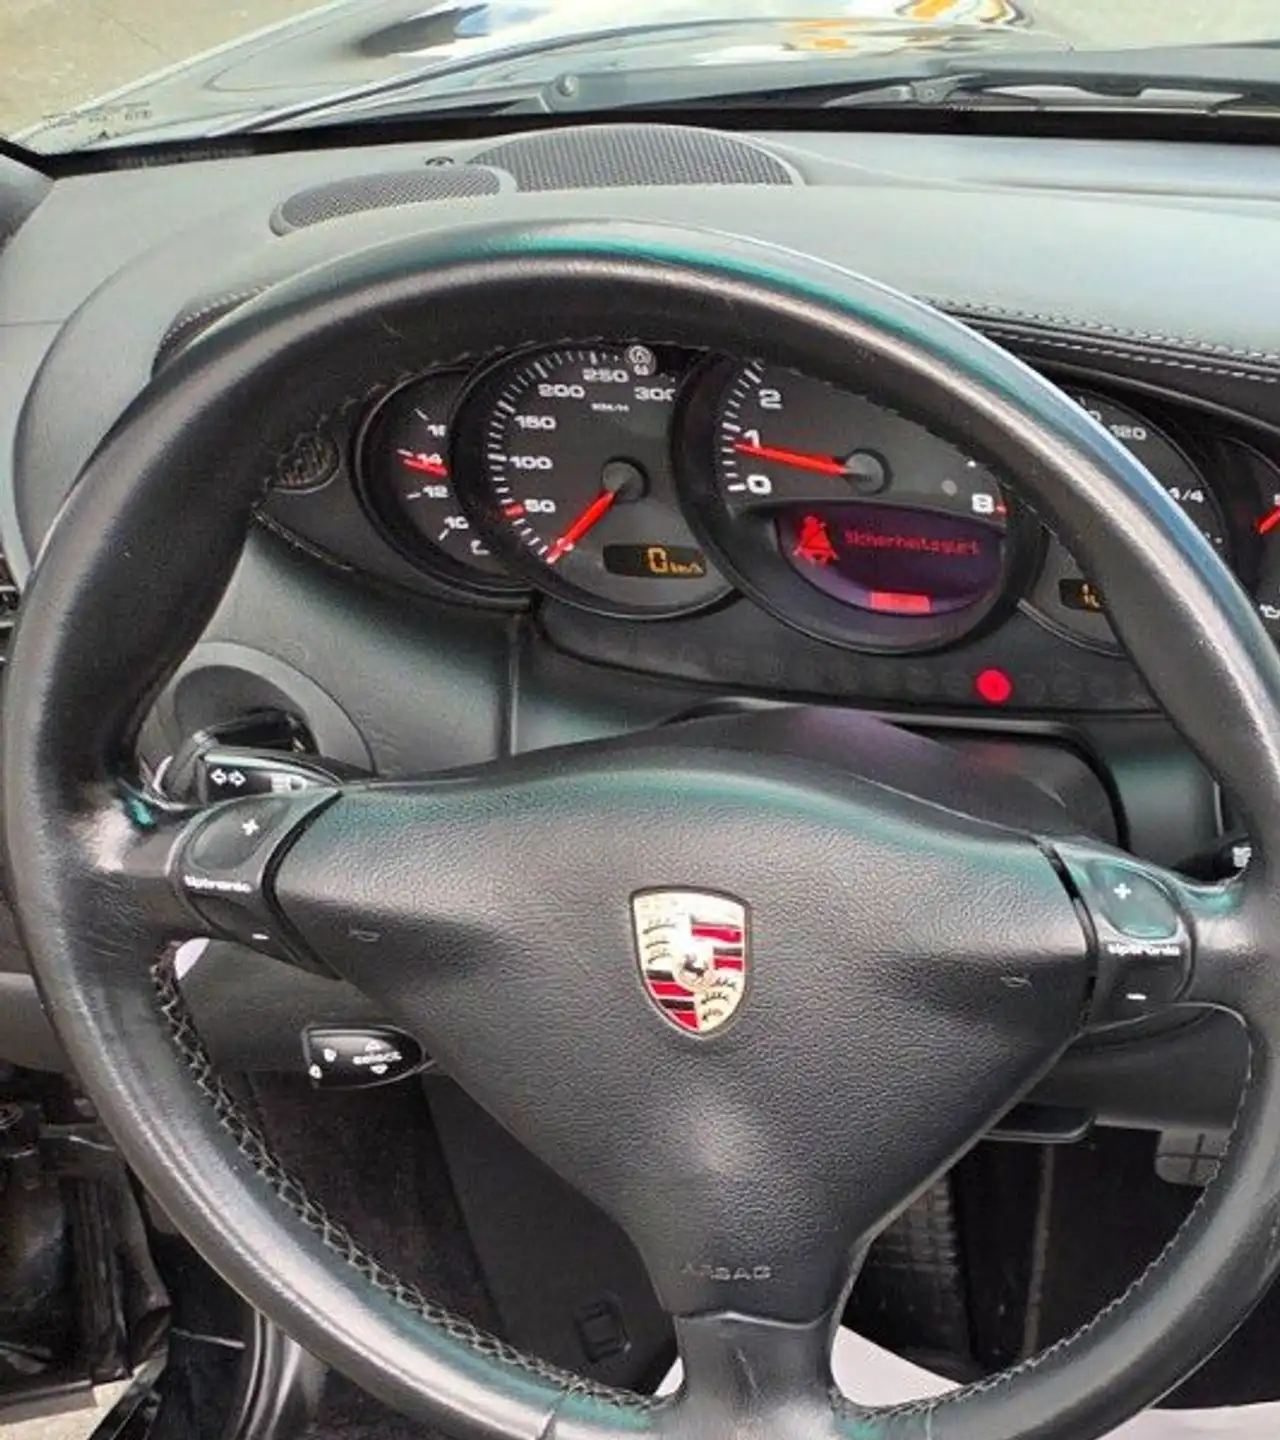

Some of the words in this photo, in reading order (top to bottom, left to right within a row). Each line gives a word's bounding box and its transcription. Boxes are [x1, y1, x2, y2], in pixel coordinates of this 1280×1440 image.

[582, 368, 629, 383] 250
[537, 384, 585, 399] 200
[758, 388, 782, 409] 2
[514, 415, 557, 430] 150
[743, 429, 762, 449] 1
[509, 455, 553, 470] 100
[746, 474, 772, 494] 0
[422, 485, 449, 499] 12
[523, 499, 556, 513] 50
[972, 493, 995, 514] 8
[444, 515, 470, 530] 10
[648, 547, 667, 574] 0
